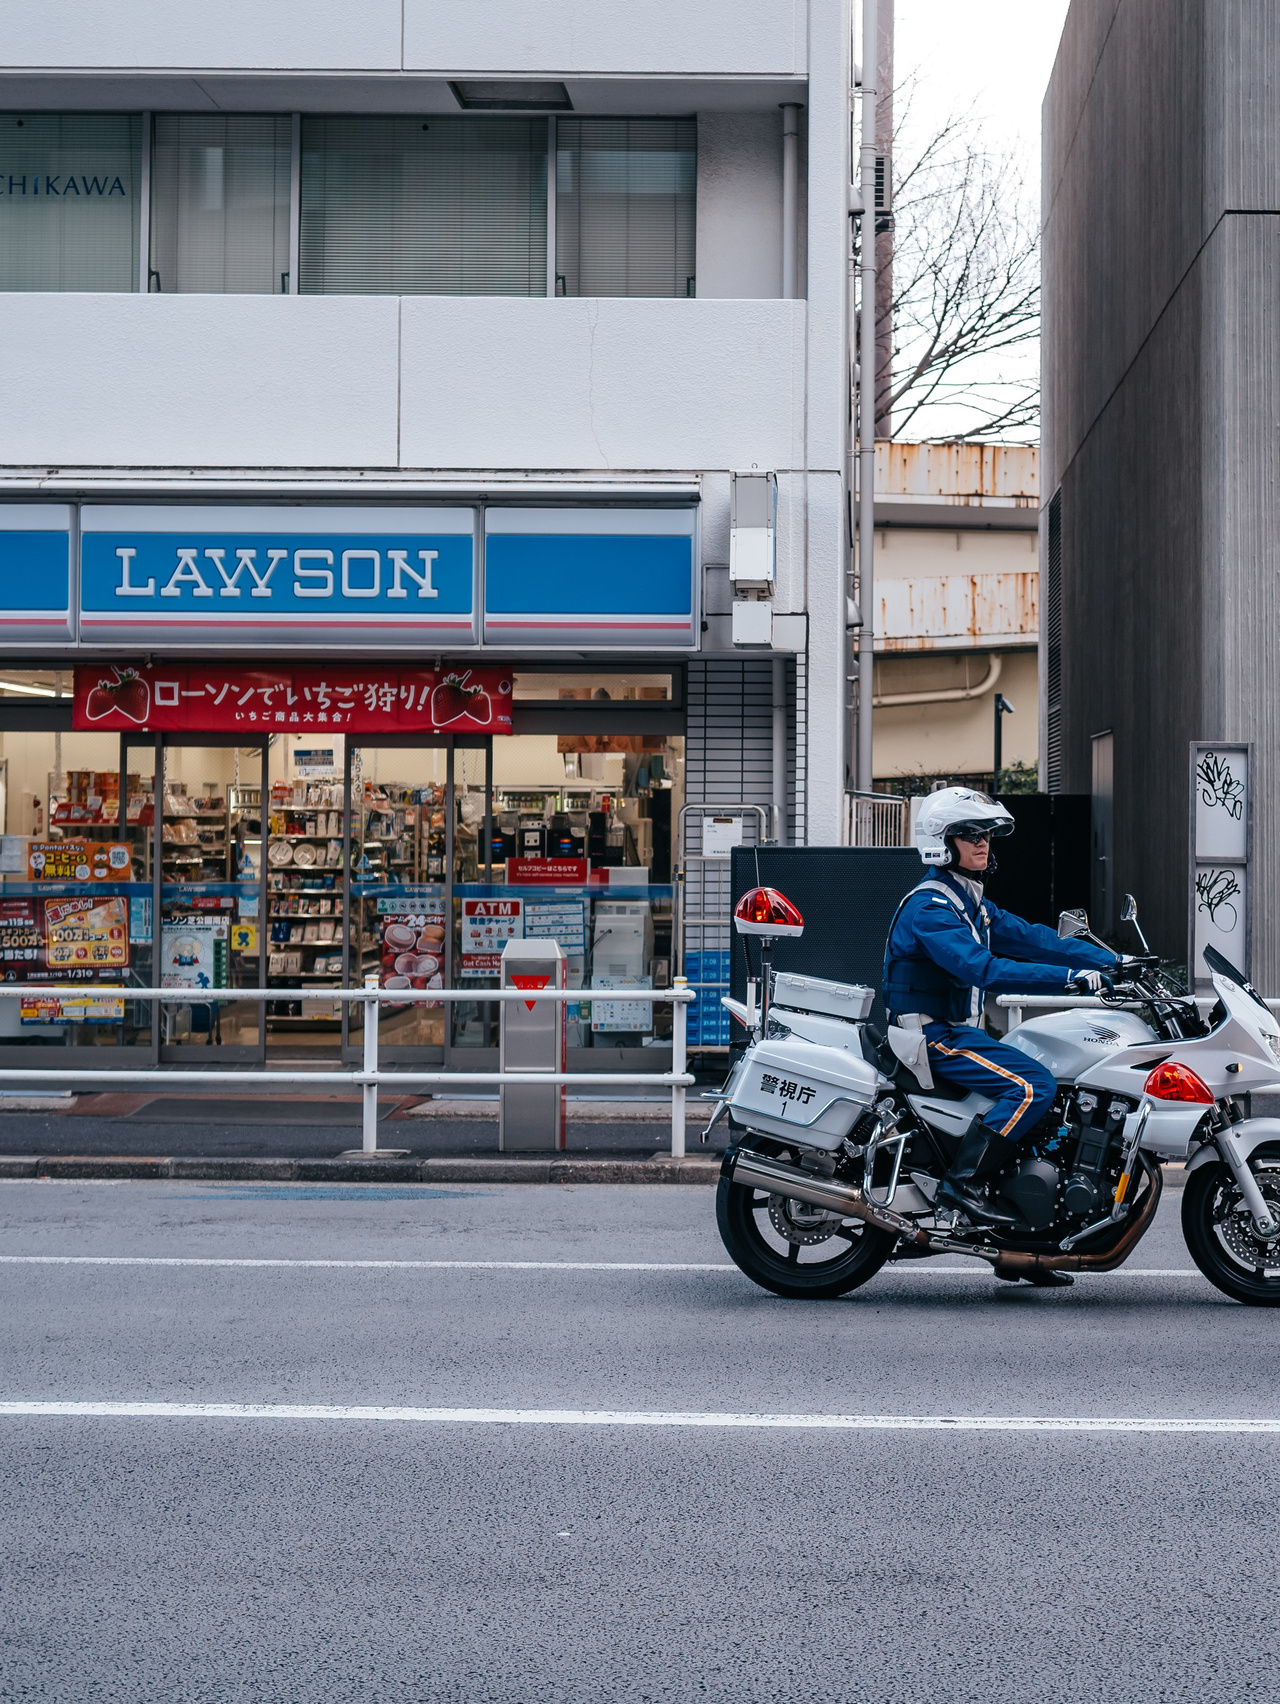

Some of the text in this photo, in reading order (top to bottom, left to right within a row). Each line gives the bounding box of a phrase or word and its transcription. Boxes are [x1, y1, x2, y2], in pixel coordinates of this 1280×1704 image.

[0, 175, 126, 196] HIKAWA
[114, 547, 439, 599] LAWSON
[154, 681, 431, 712] ローソンでいちご狩り!
[234, 711, 351, 723] いちご商品大集合!
[474, 903, 511, 915] ATM
[161, 915, 230, 926] ーソン芝公園南店
[1083, 1036, 1119, 1047] HONDA
[760, 1073, 817, 1105] 警視庁
[782, 1101, 788, 1116] 1
